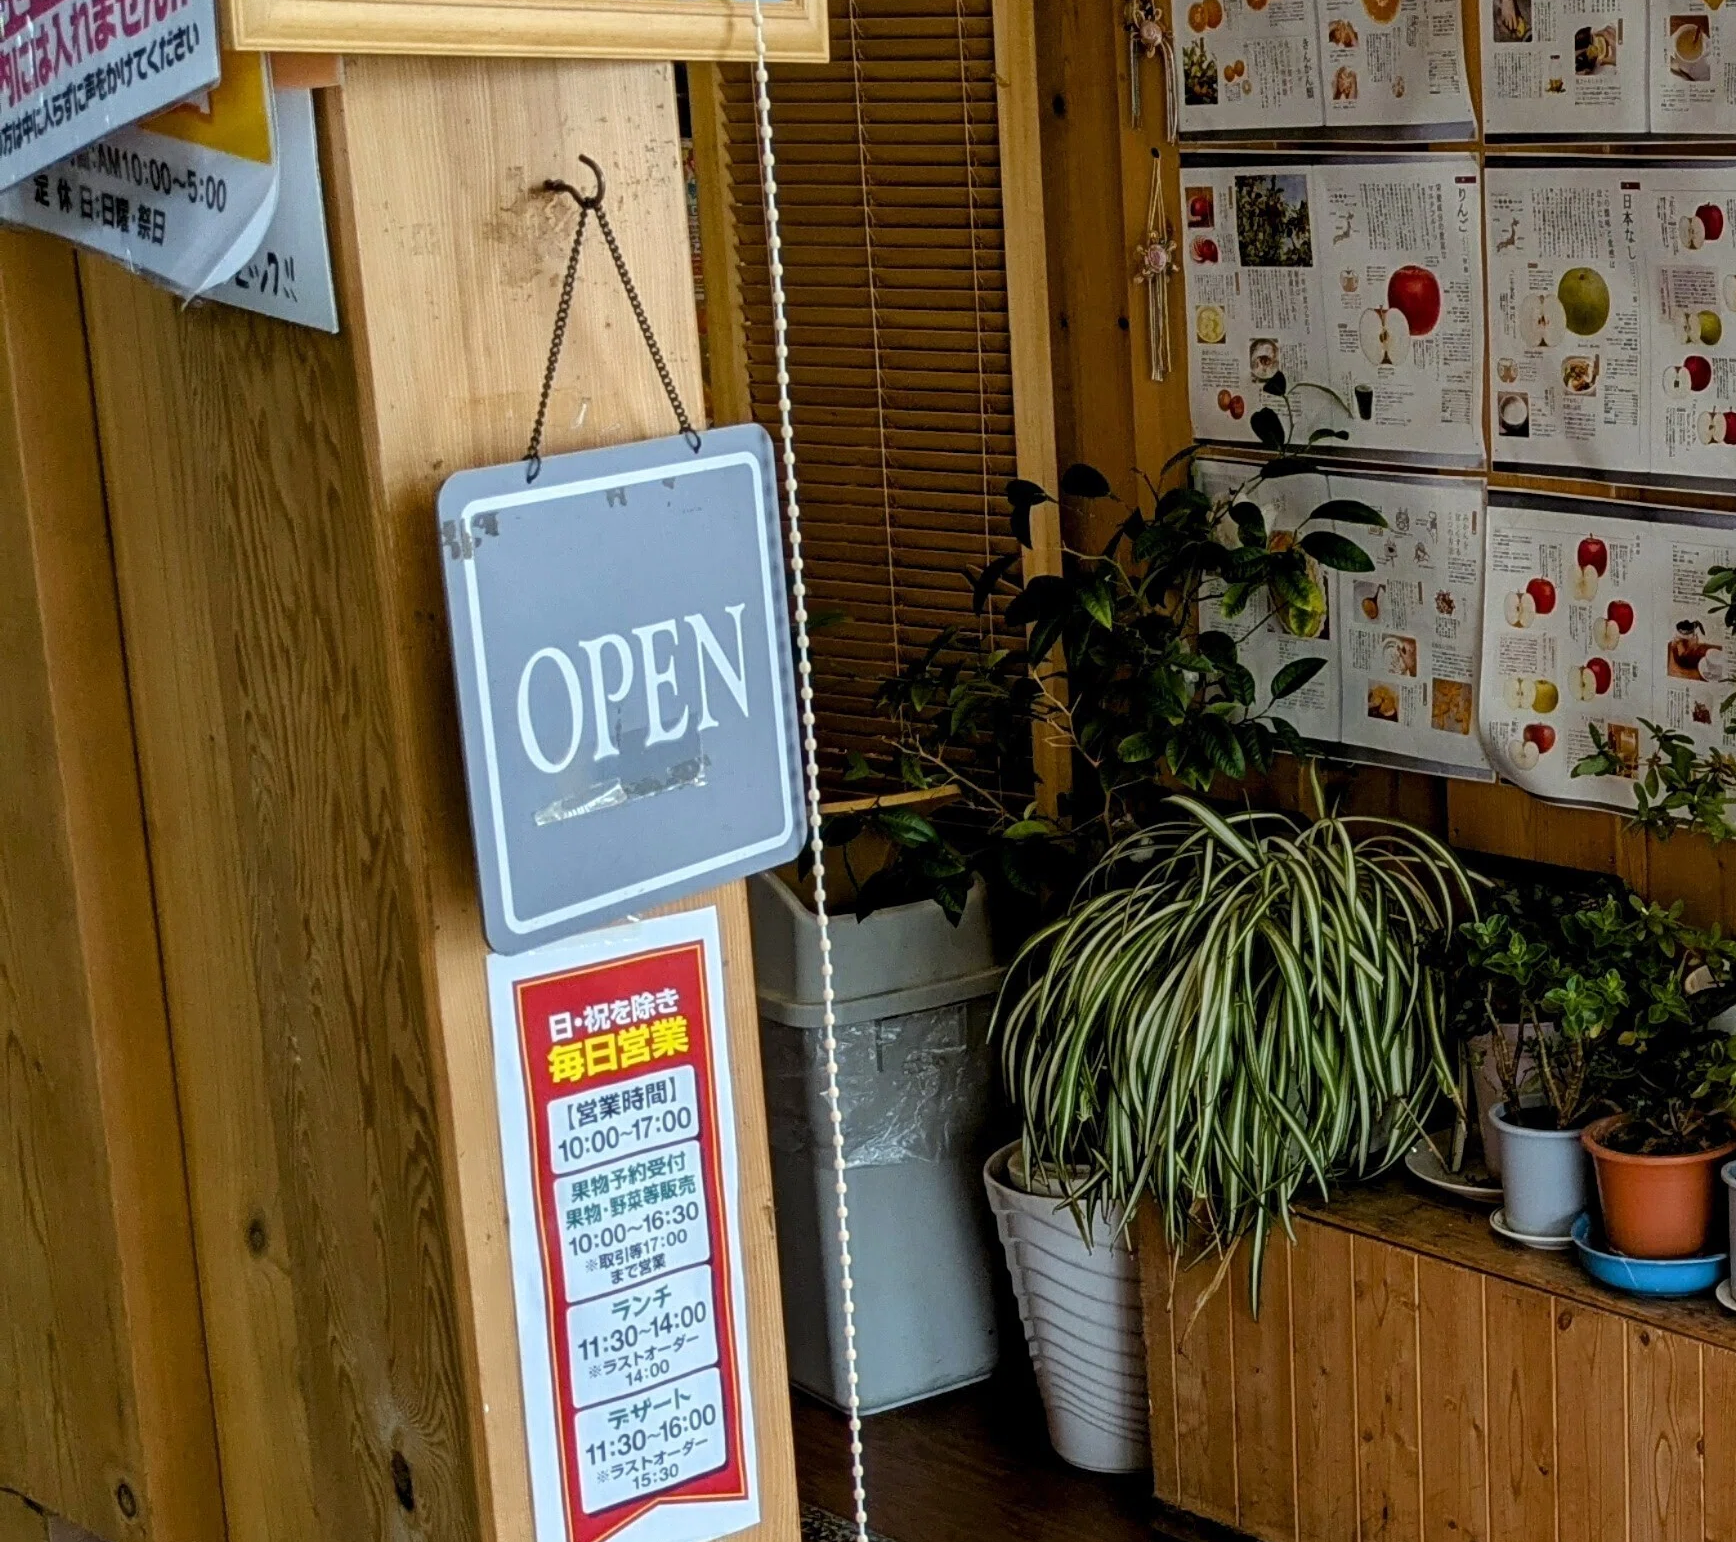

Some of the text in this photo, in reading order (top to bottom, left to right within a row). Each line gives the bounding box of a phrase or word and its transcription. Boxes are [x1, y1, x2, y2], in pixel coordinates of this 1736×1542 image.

[0, 22, 199, 157] 方は中に入らずに声をかけてください
[1622, 193, 1637, 261] 日本なし
[517, 602, 750, 774] OPEN
[548, 988, 680, 1041] 日・祝を除き
[547, 1015, 690, 1084] 毎日営業
[571, 1150, 686, 1202] 果物予約受付
[565, 1174, 697, 1231] 果物・野菜等販売
[610, 1252, 667, 1285] まで営業
[611, 1284, 672, 1322] ランチ
[625, 1359, 671, 1387] 14:00
[608, 1387, 692, 1430] デザート
[631, 1463, 680, 1491] 15:30
